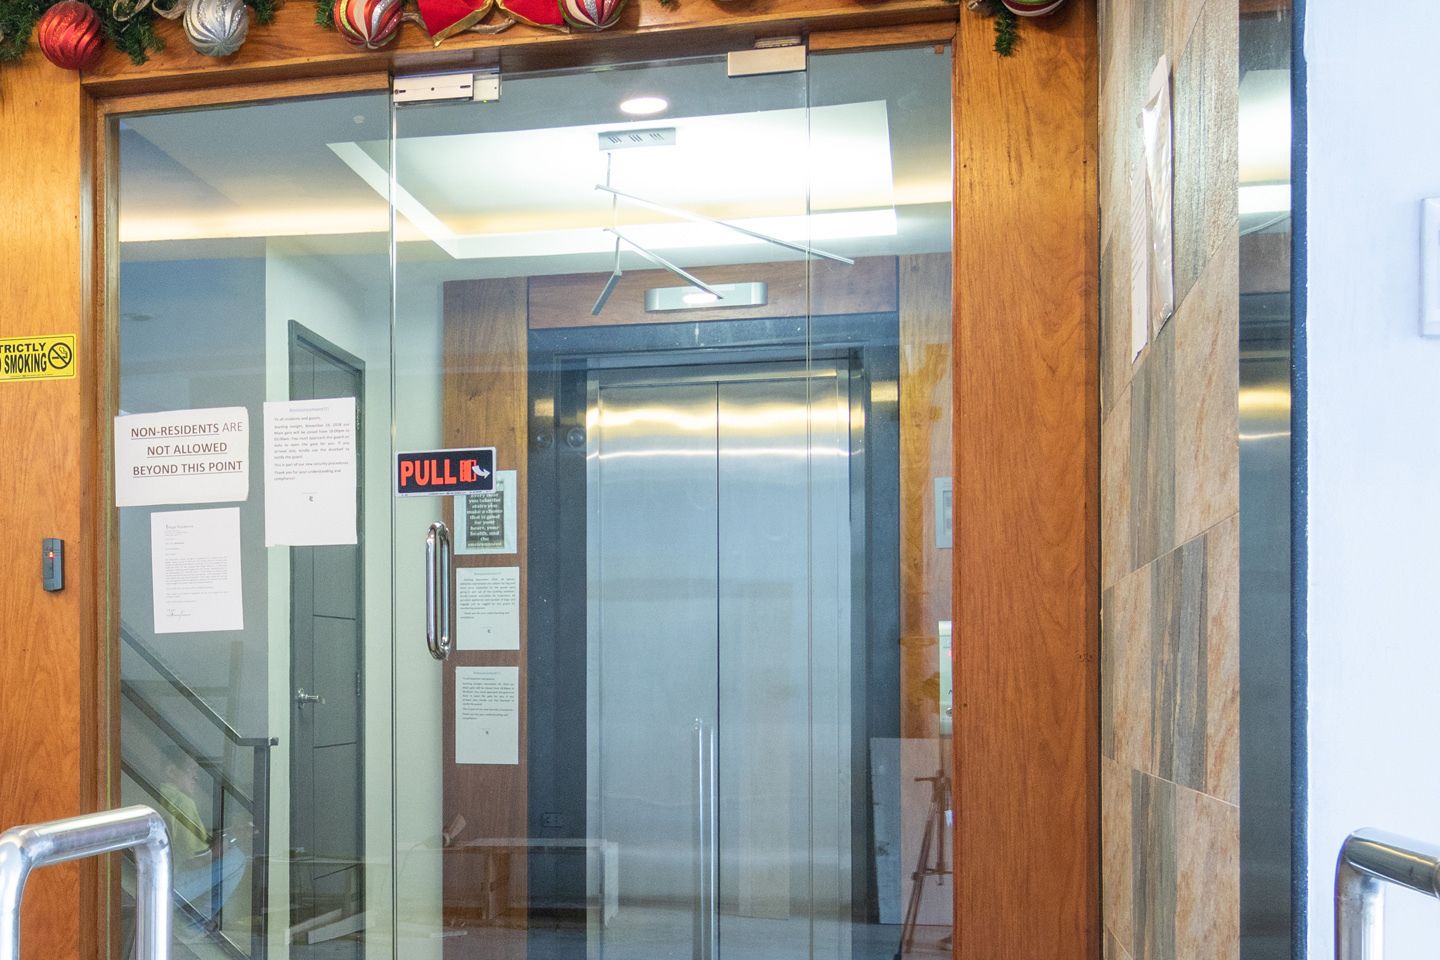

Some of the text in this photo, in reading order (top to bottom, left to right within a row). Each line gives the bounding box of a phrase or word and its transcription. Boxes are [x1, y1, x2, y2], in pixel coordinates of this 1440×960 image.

[4, 353, 47, 374] SMOKING
[131, 421, 243, 437] NON-RESIDENTS ARE
[147, 442, 227, 456] NOT ALLOWED
[133, 460, 243, 476] BEYOND THIS POINT
[400, 459, 457, 487] PULL
